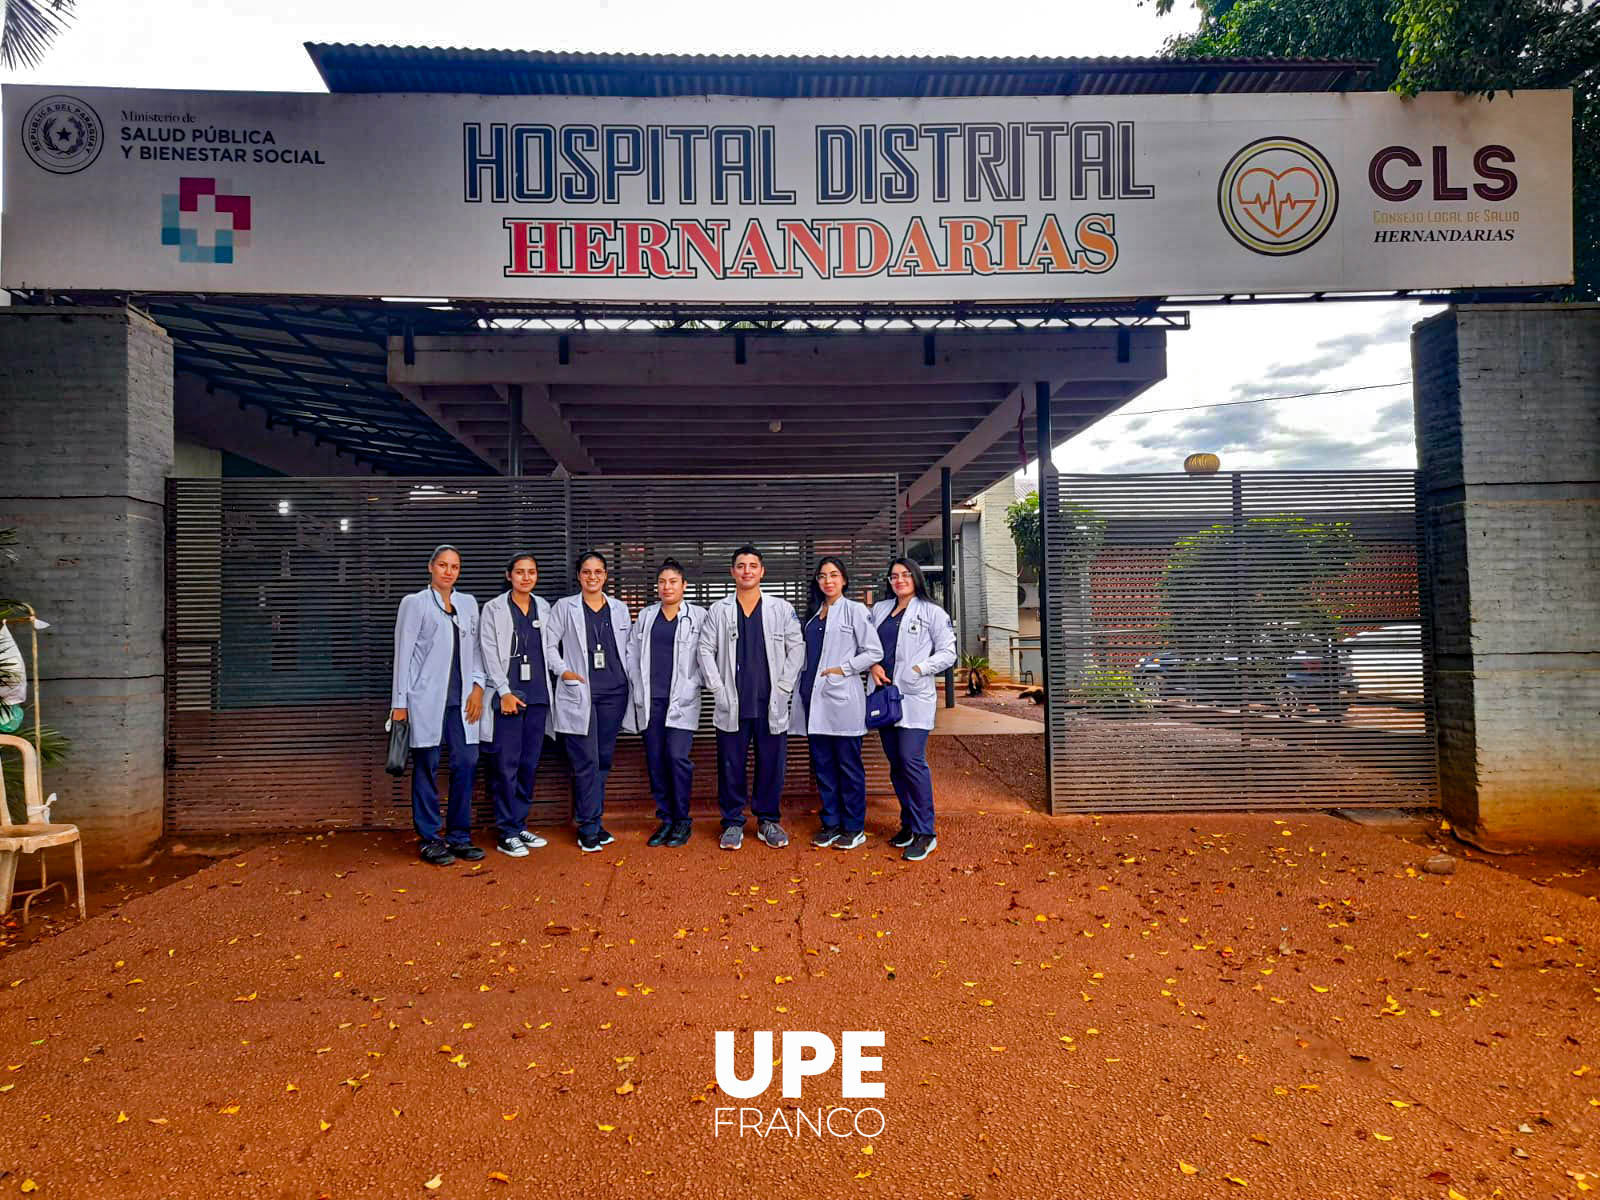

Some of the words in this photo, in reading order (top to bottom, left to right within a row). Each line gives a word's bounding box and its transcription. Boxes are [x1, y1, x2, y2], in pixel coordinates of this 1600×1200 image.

[55, 103, 73, 112] DEL
[74, 107, 97, 154] PARAGUAY
[121, 110, 180, 123] Ministerio
[182, 113, 197, 123] de
[121, 127, 186, 142] SALUD
[192, 125, 276, 145] PÚBLICA
[121, 145, 134, 159] Y
[140, 146, 246, 163] BIENESTAR
[253, 149, 325, 165] SOCIAL
[462, 122, 796, 205] HOSPITAL
[815, 120, 1155, 201] DISTRITAL
[1368, 145, 1518, 201] CLS
[503, 212, 1119, 281] HERNANDARIAS
[1374, 229, 1515, 243] HERNANDARIAS
